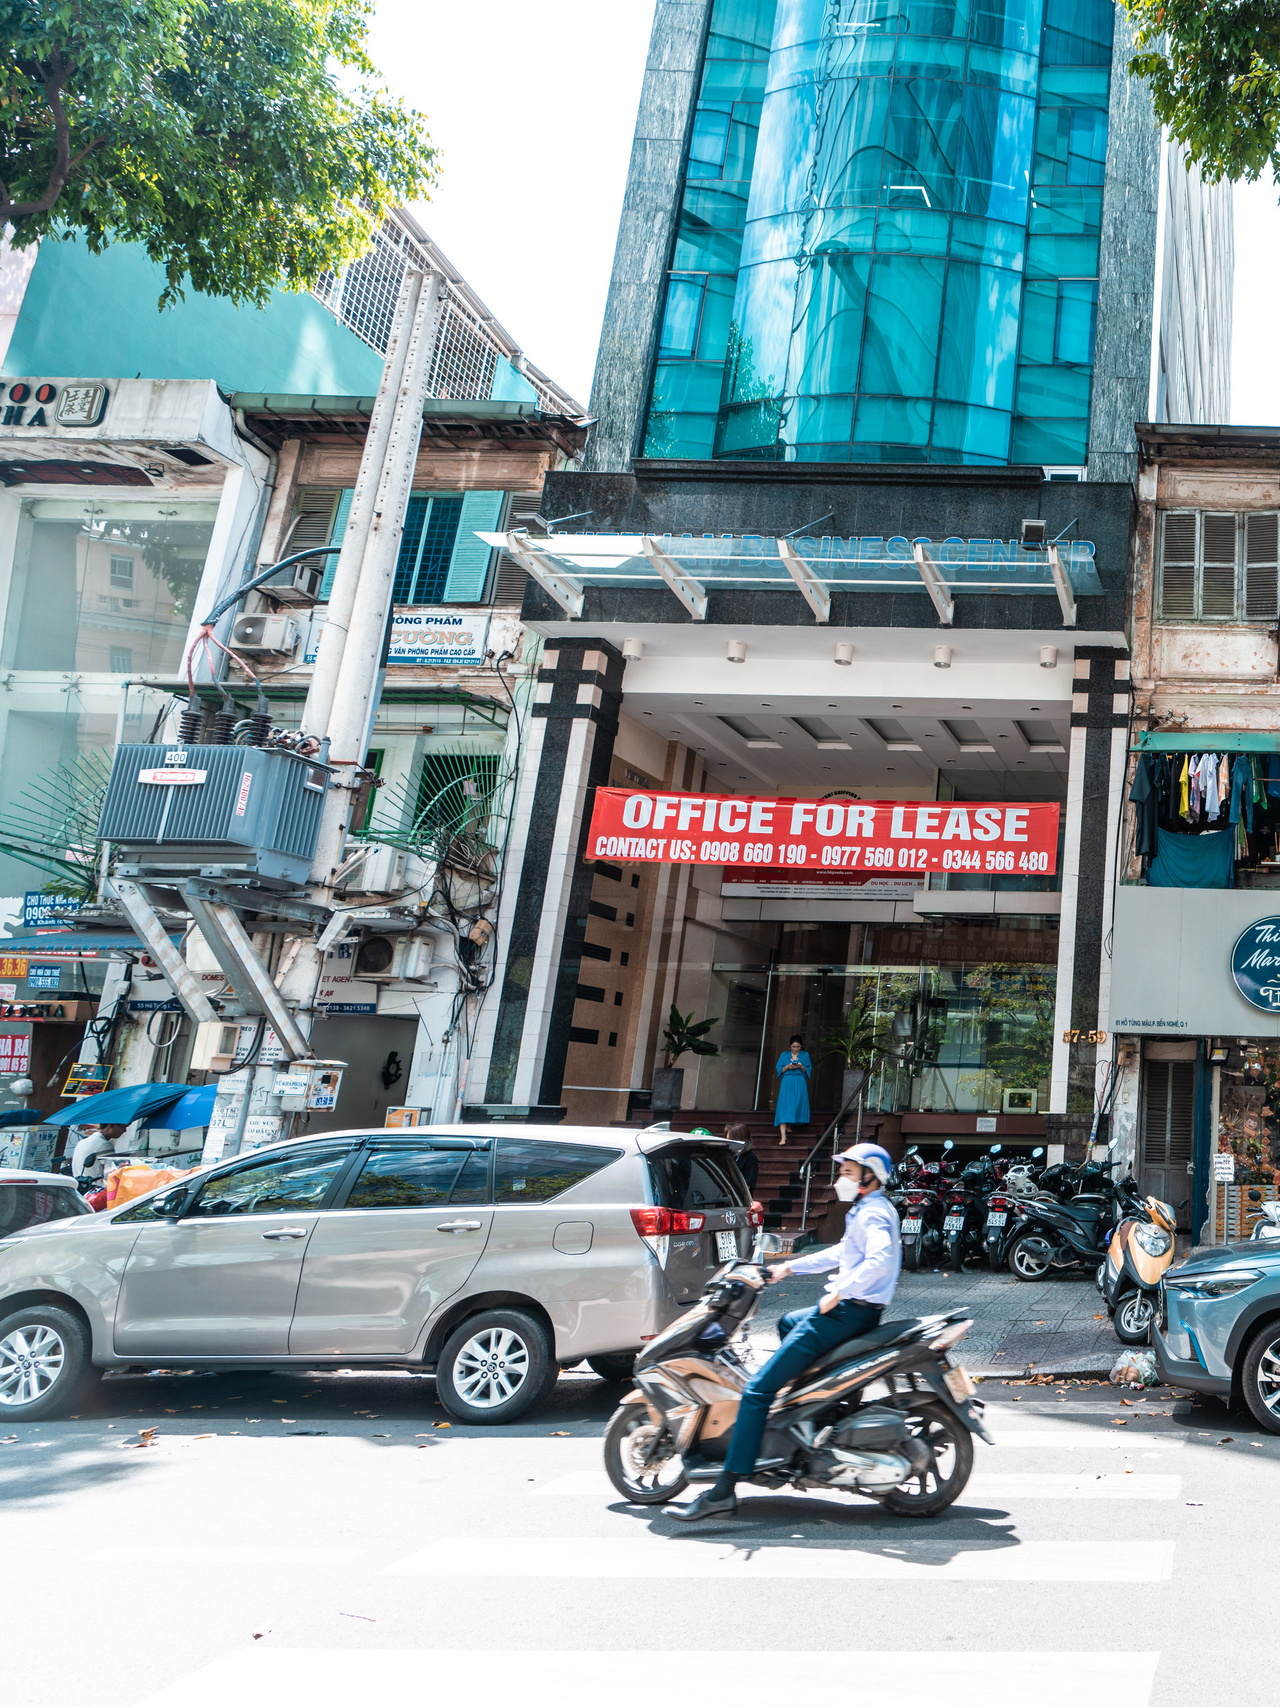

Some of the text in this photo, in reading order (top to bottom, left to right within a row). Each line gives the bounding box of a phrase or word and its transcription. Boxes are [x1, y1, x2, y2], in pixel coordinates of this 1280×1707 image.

[0, 383, 56, 404] OO
[0, 405, 47, 427] HA
[167, 753, 186, 762] 400
[622, 794, 1030, 842] OFFICE FOR LEASE
[595, 835, 667, 858] CONTACT
[669, 838, 696, 861] US:
[700, 840, 740, 862] 0908
[743, 842, 773, 863] 660
[778, 843, 807, 865] 190
[821, 845, 861, 867] 0977
[864, 846, 894, 867] 560
[897, 848, 928, 868] 012
[942, 848, 981, 870] 0344
[985, 850, 1015, 871] 566
[1018, 851, 1049, 871] 480
[27, 895, 38, 906] CHO
[1062, 1029, 1107, 1044] 57-59
